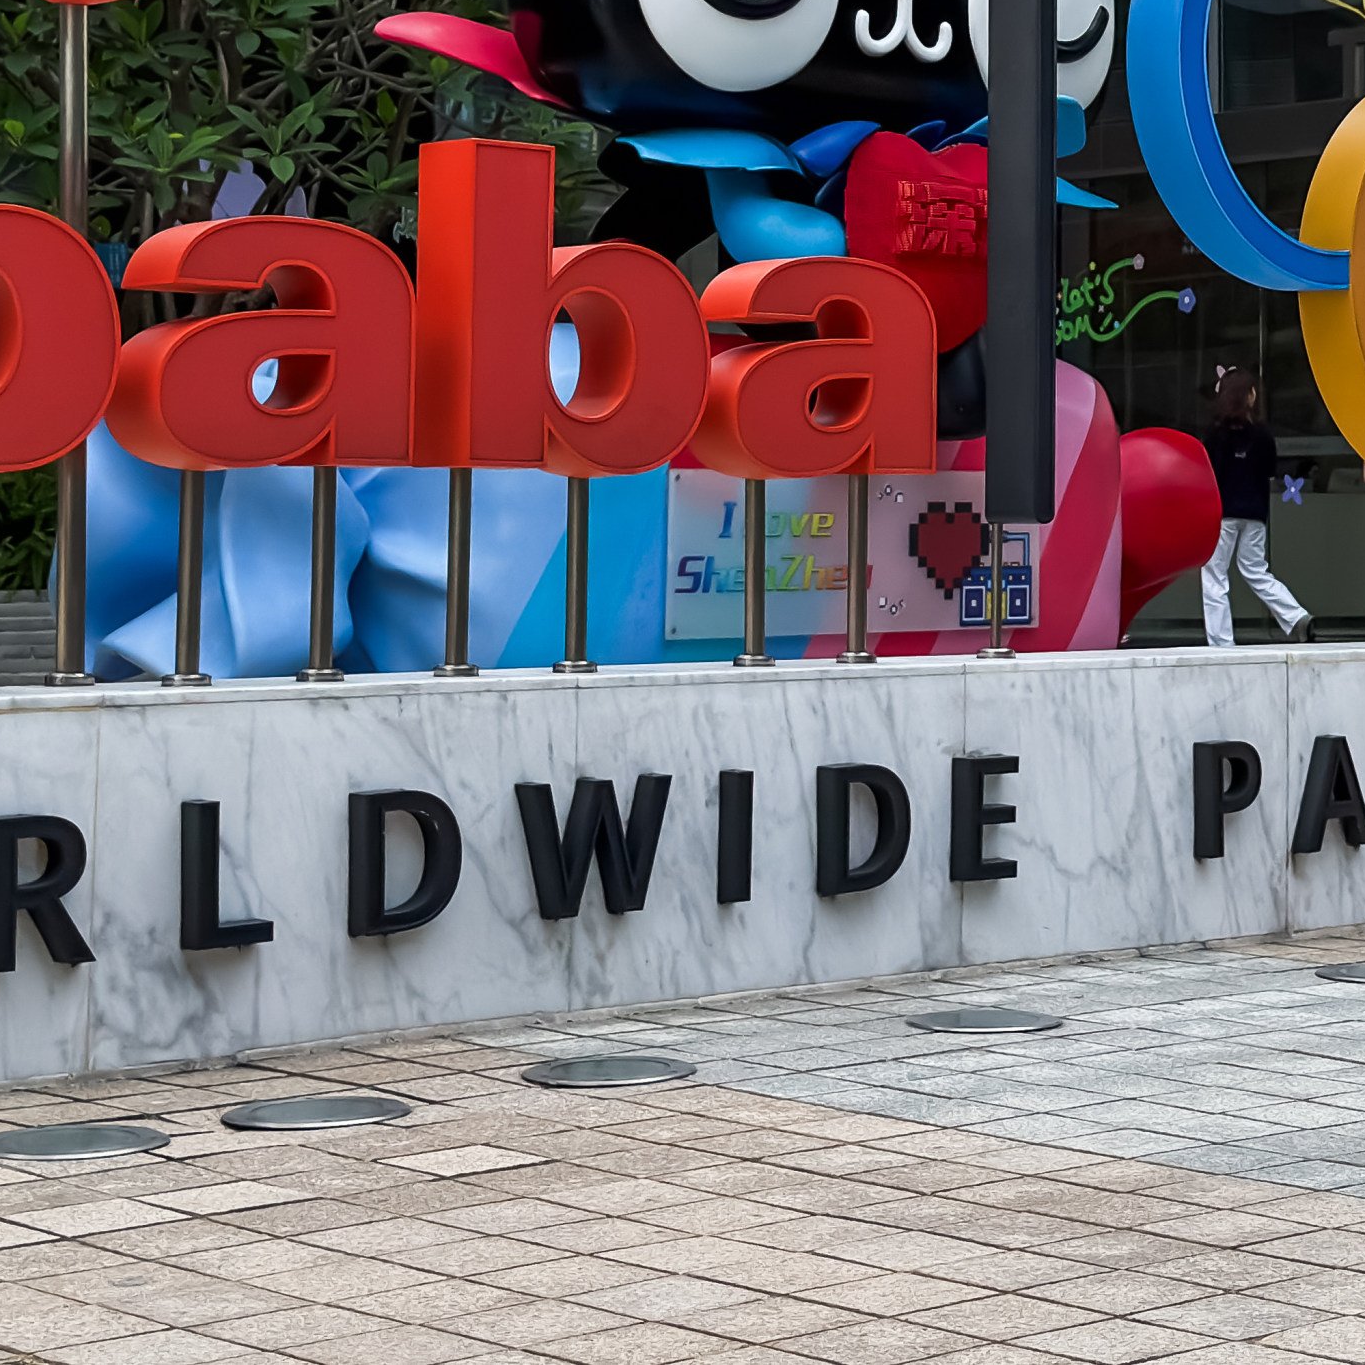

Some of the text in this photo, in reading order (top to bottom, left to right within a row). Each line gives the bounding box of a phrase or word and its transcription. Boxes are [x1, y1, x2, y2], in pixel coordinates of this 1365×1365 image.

[895, 180, 988, 255] 深
[718, 501, 835, 539] I ove
